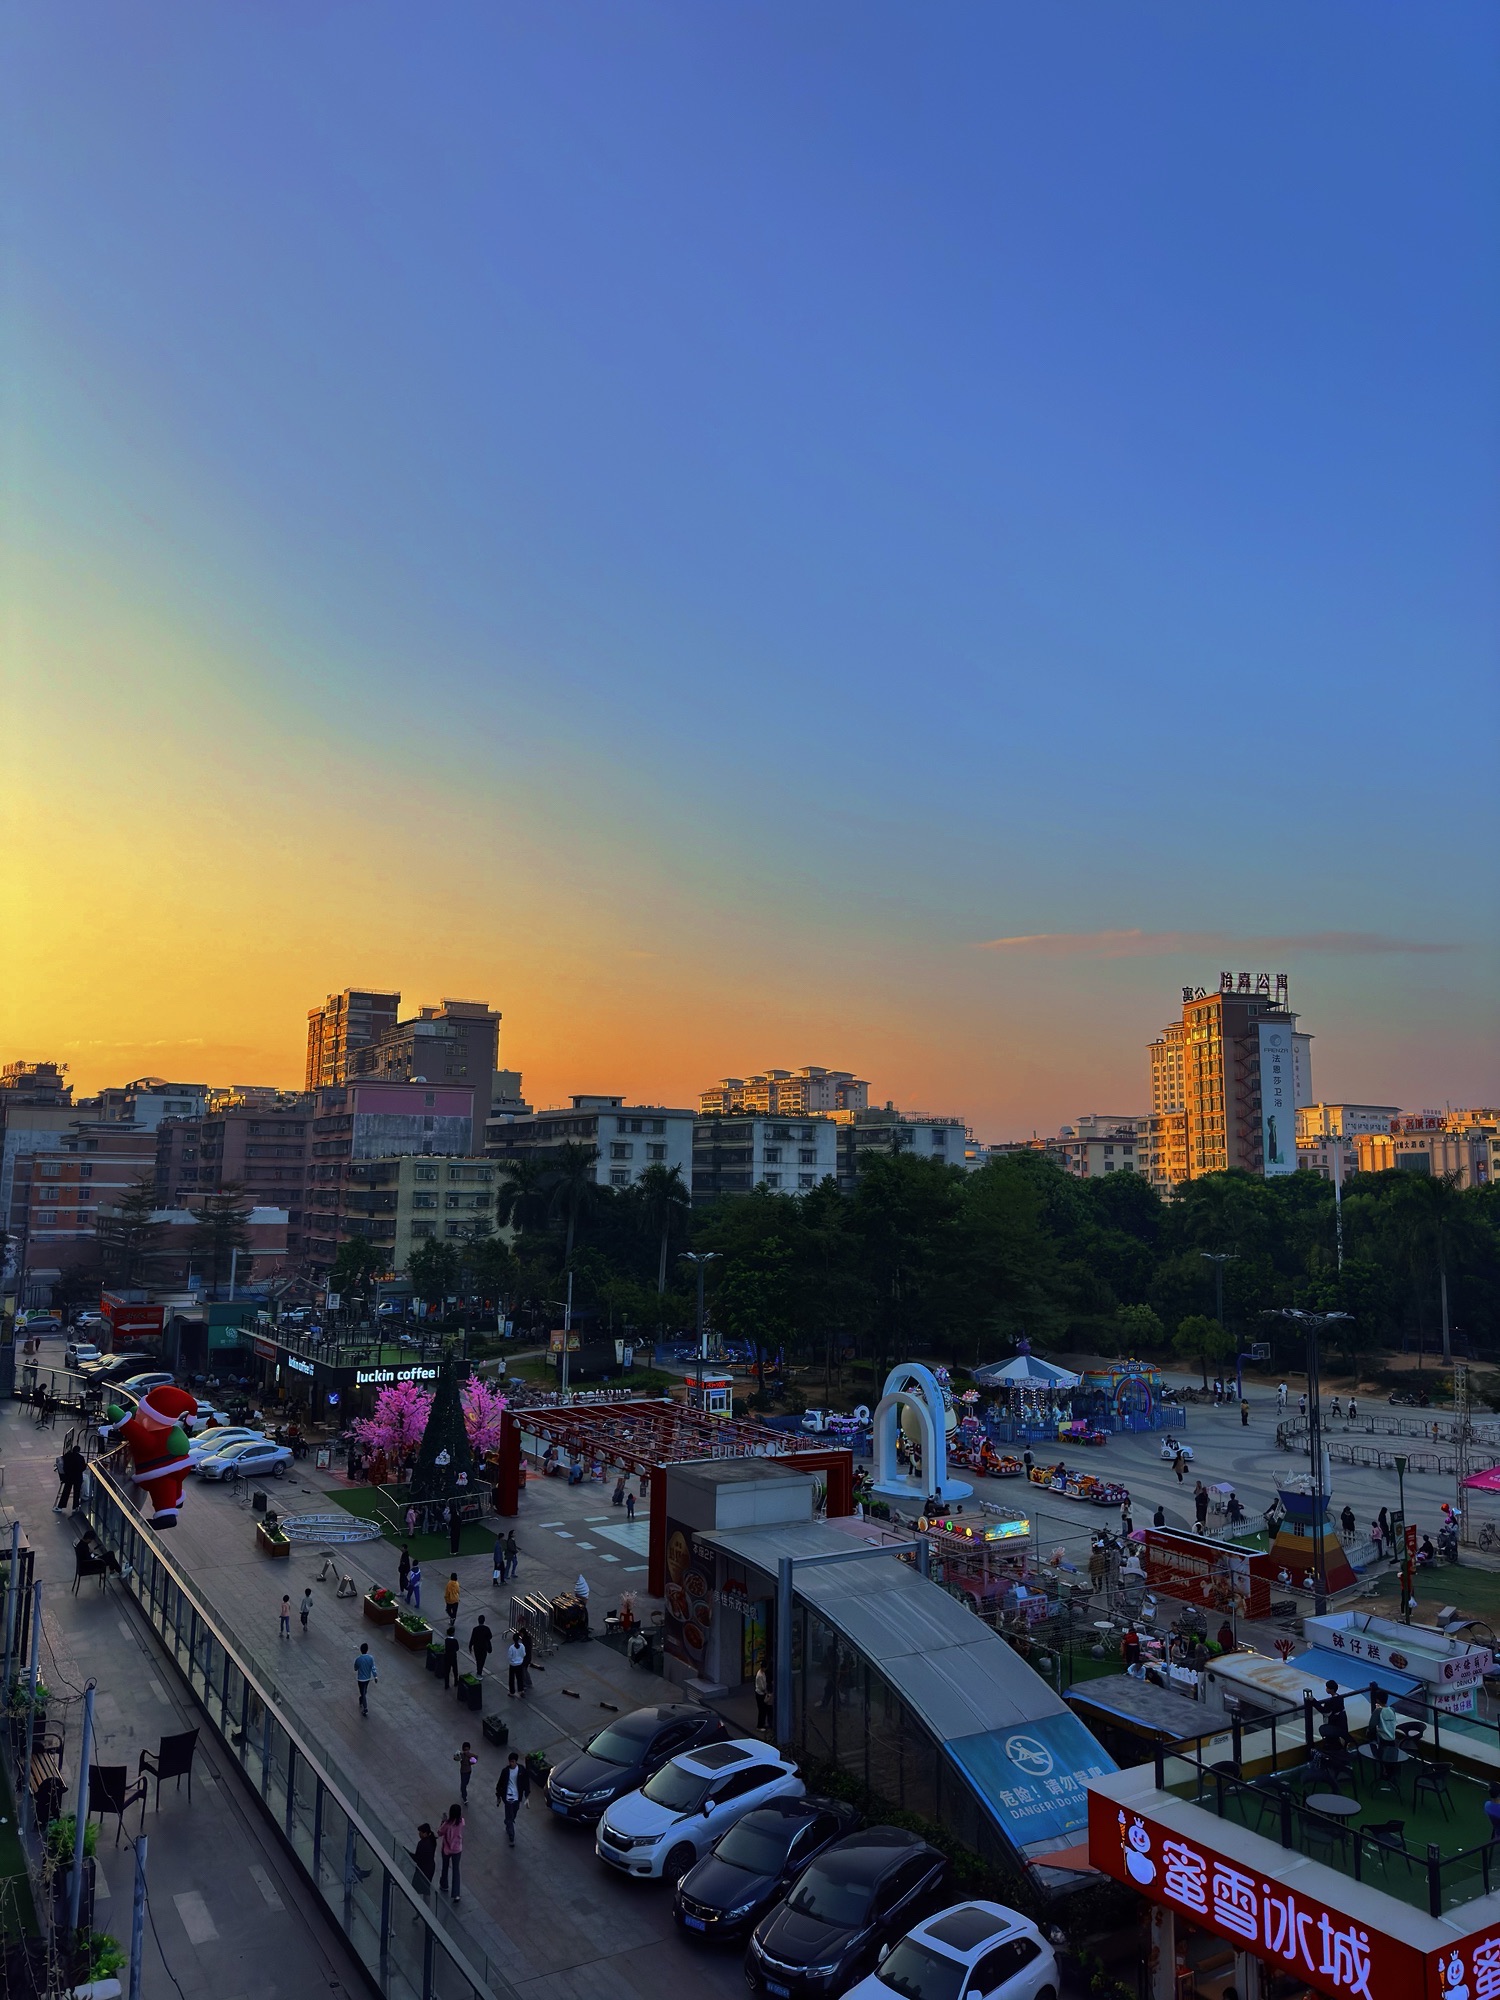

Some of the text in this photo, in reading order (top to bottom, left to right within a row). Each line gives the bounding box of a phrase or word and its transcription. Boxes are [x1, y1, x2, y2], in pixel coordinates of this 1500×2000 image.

[1222, 972, 1288, 990] 怡嘉公寓
[1271, 1053, 1283, 1108] 法恩莎卫浴
[356, 1367, 436, 1384] luckin coffee
[1332, 1632, 1381, 1660] 钵仔糕
[1010, 1800, 1057, 1819] DANGER!
[1057, 1797, 1071, 1808] Do
[1162, 1839, 1373, 2000] 蜜雪冰城
